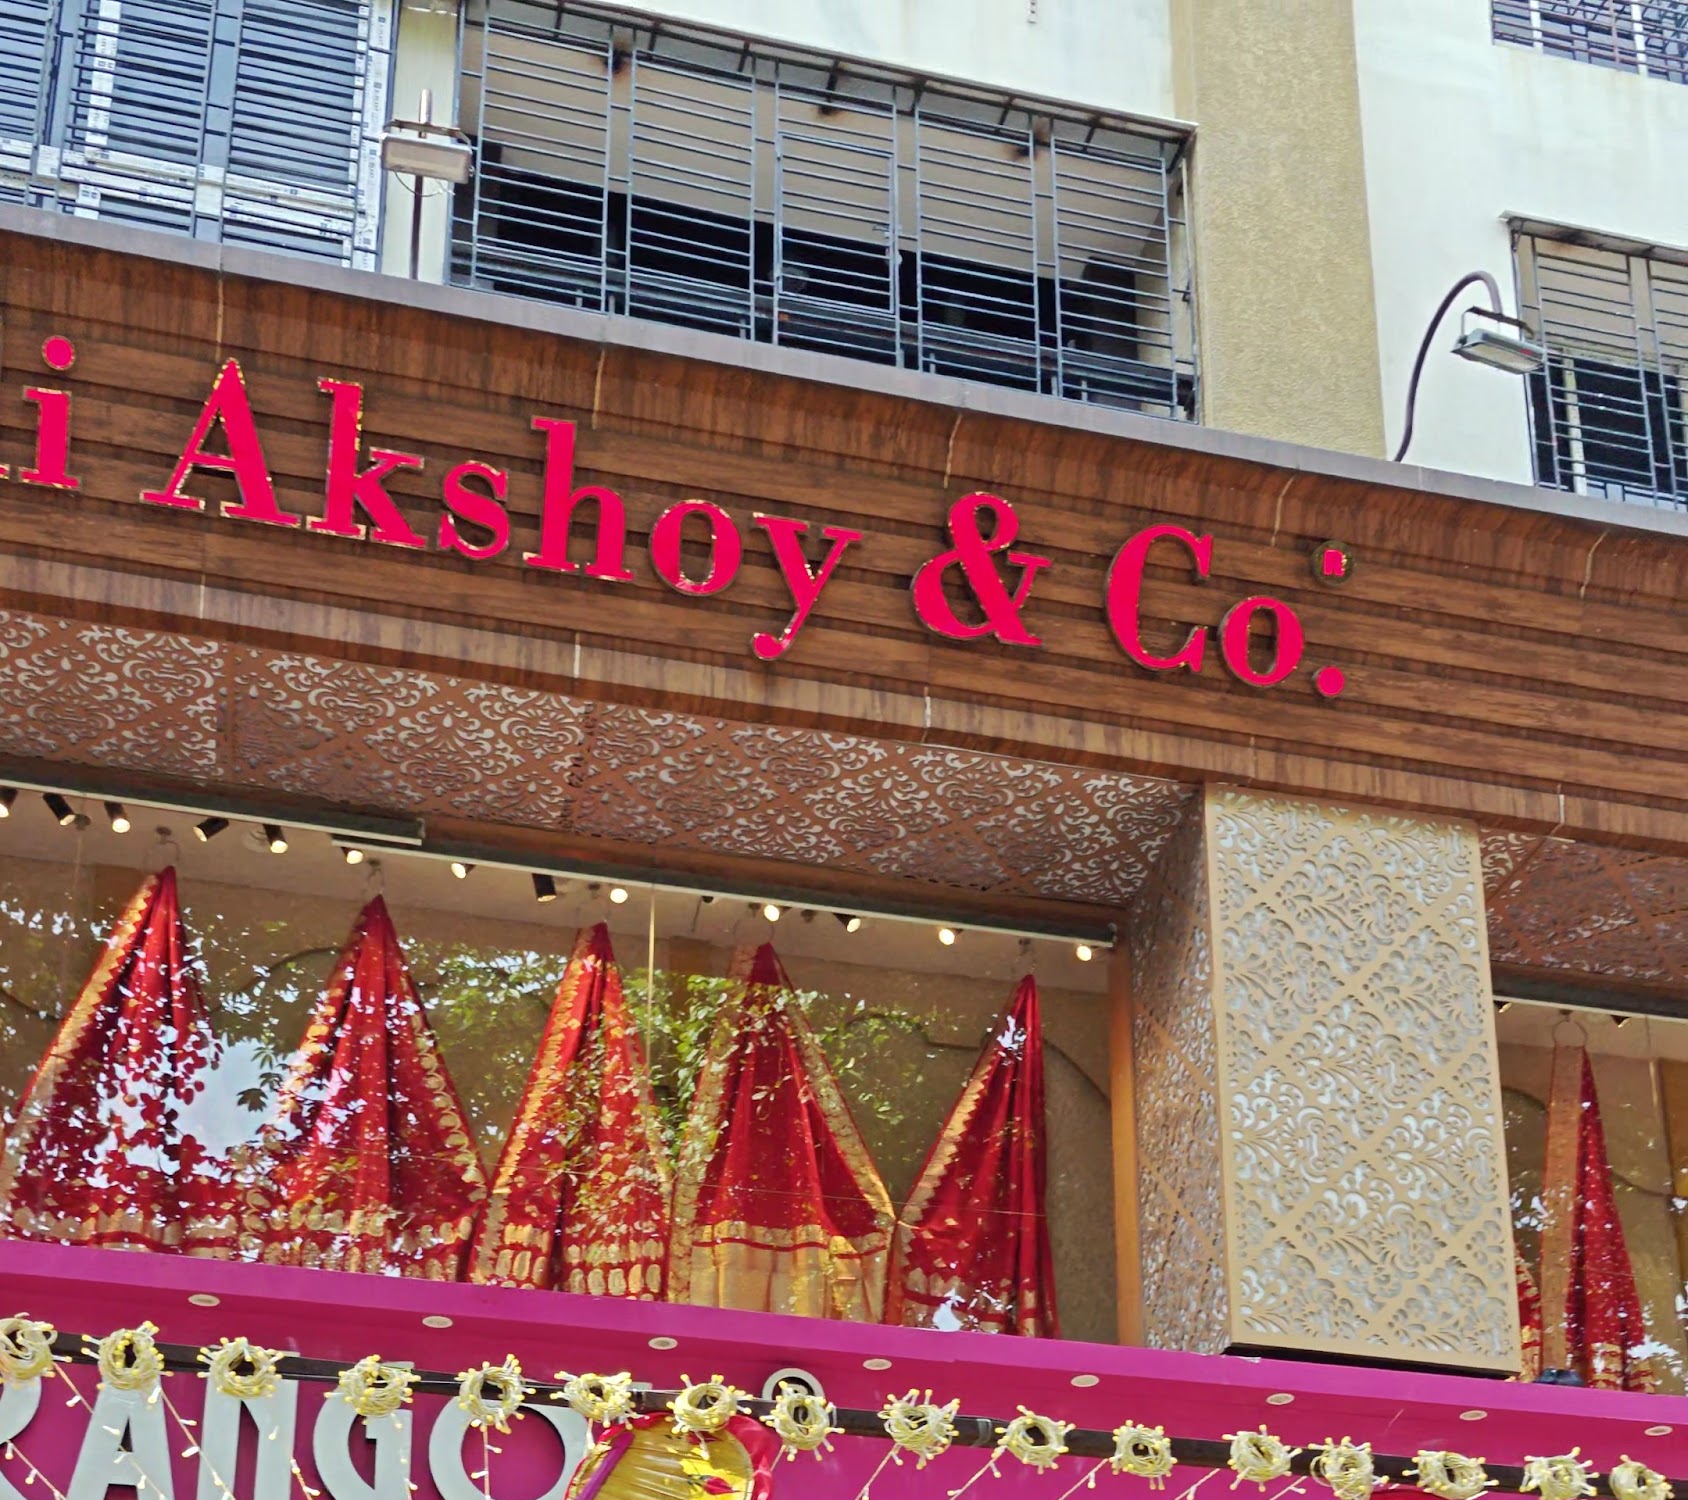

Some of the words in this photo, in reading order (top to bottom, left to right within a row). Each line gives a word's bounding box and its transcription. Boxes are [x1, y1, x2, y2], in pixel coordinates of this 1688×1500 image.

[12, 335, 81, 490] i
[139, 358, 866, 662] Akshoy
[912, 491, 1053, 648] &
[1106, 523, 1347, 698] Co.
